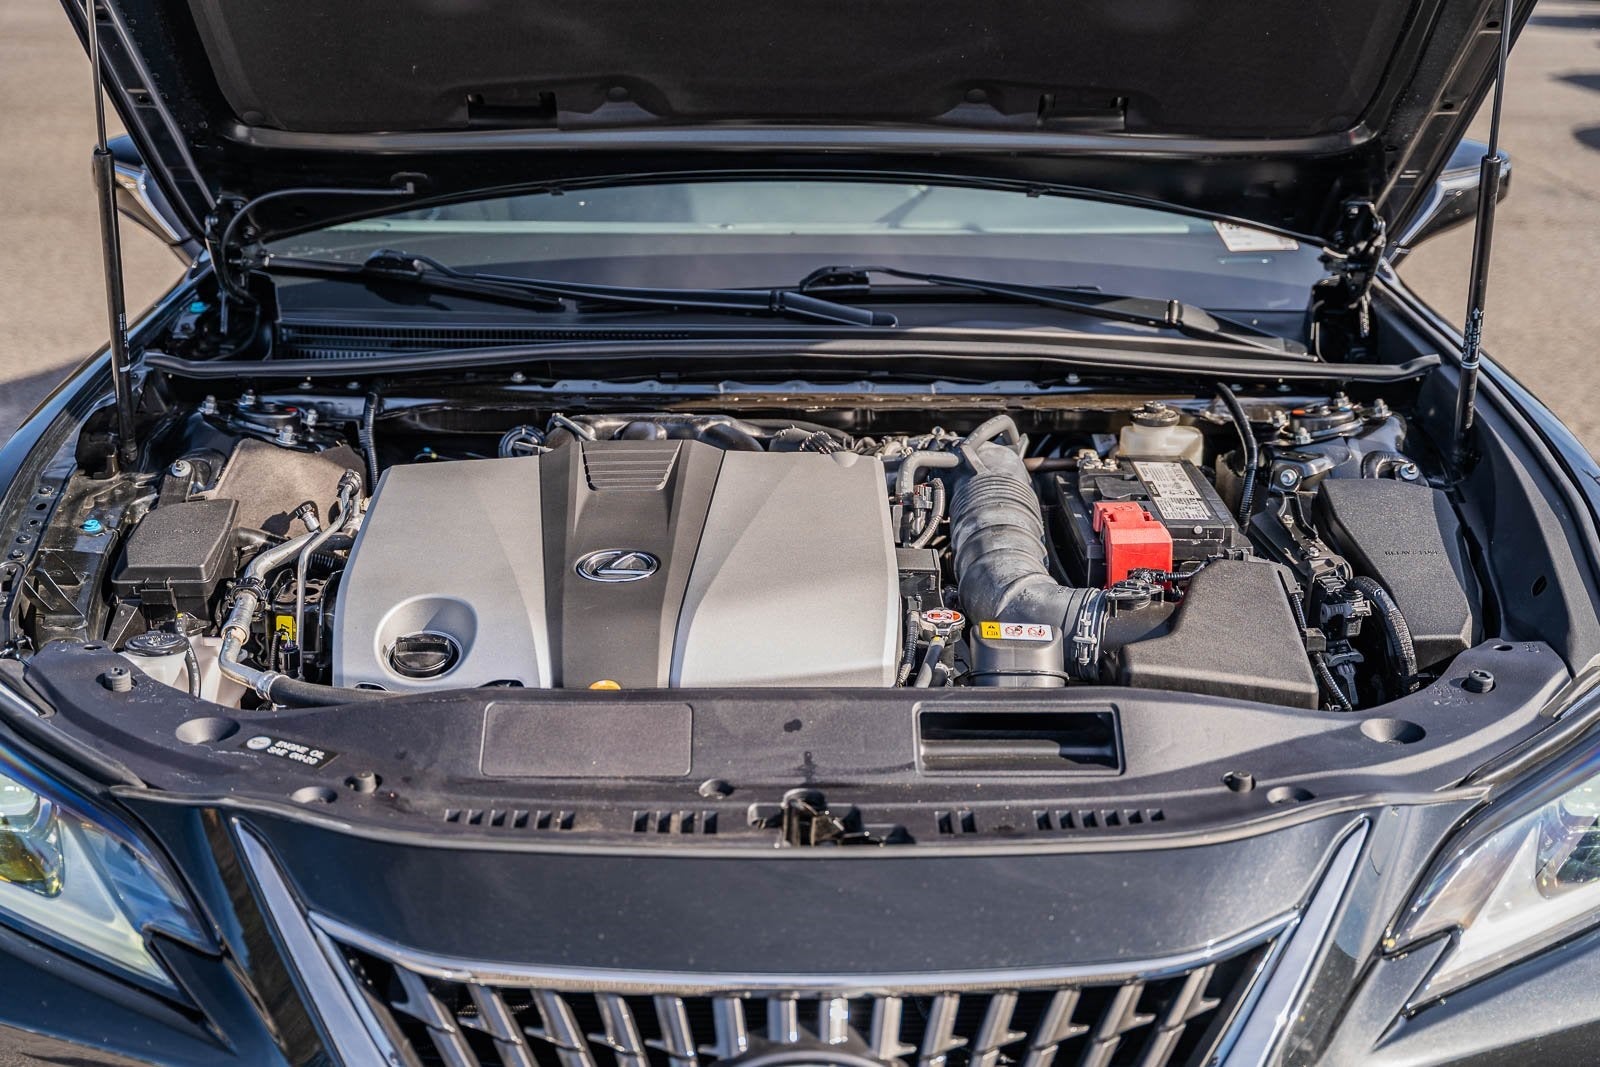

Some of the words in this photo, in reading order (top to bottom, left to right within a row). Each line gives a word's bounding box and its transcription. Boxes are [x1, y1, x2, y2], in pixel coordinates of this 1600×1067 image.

[266, 745, 289, 757] SAE
[274, 740, 310, 754] ENGINE
[309, 749, 326, 760] OIL
